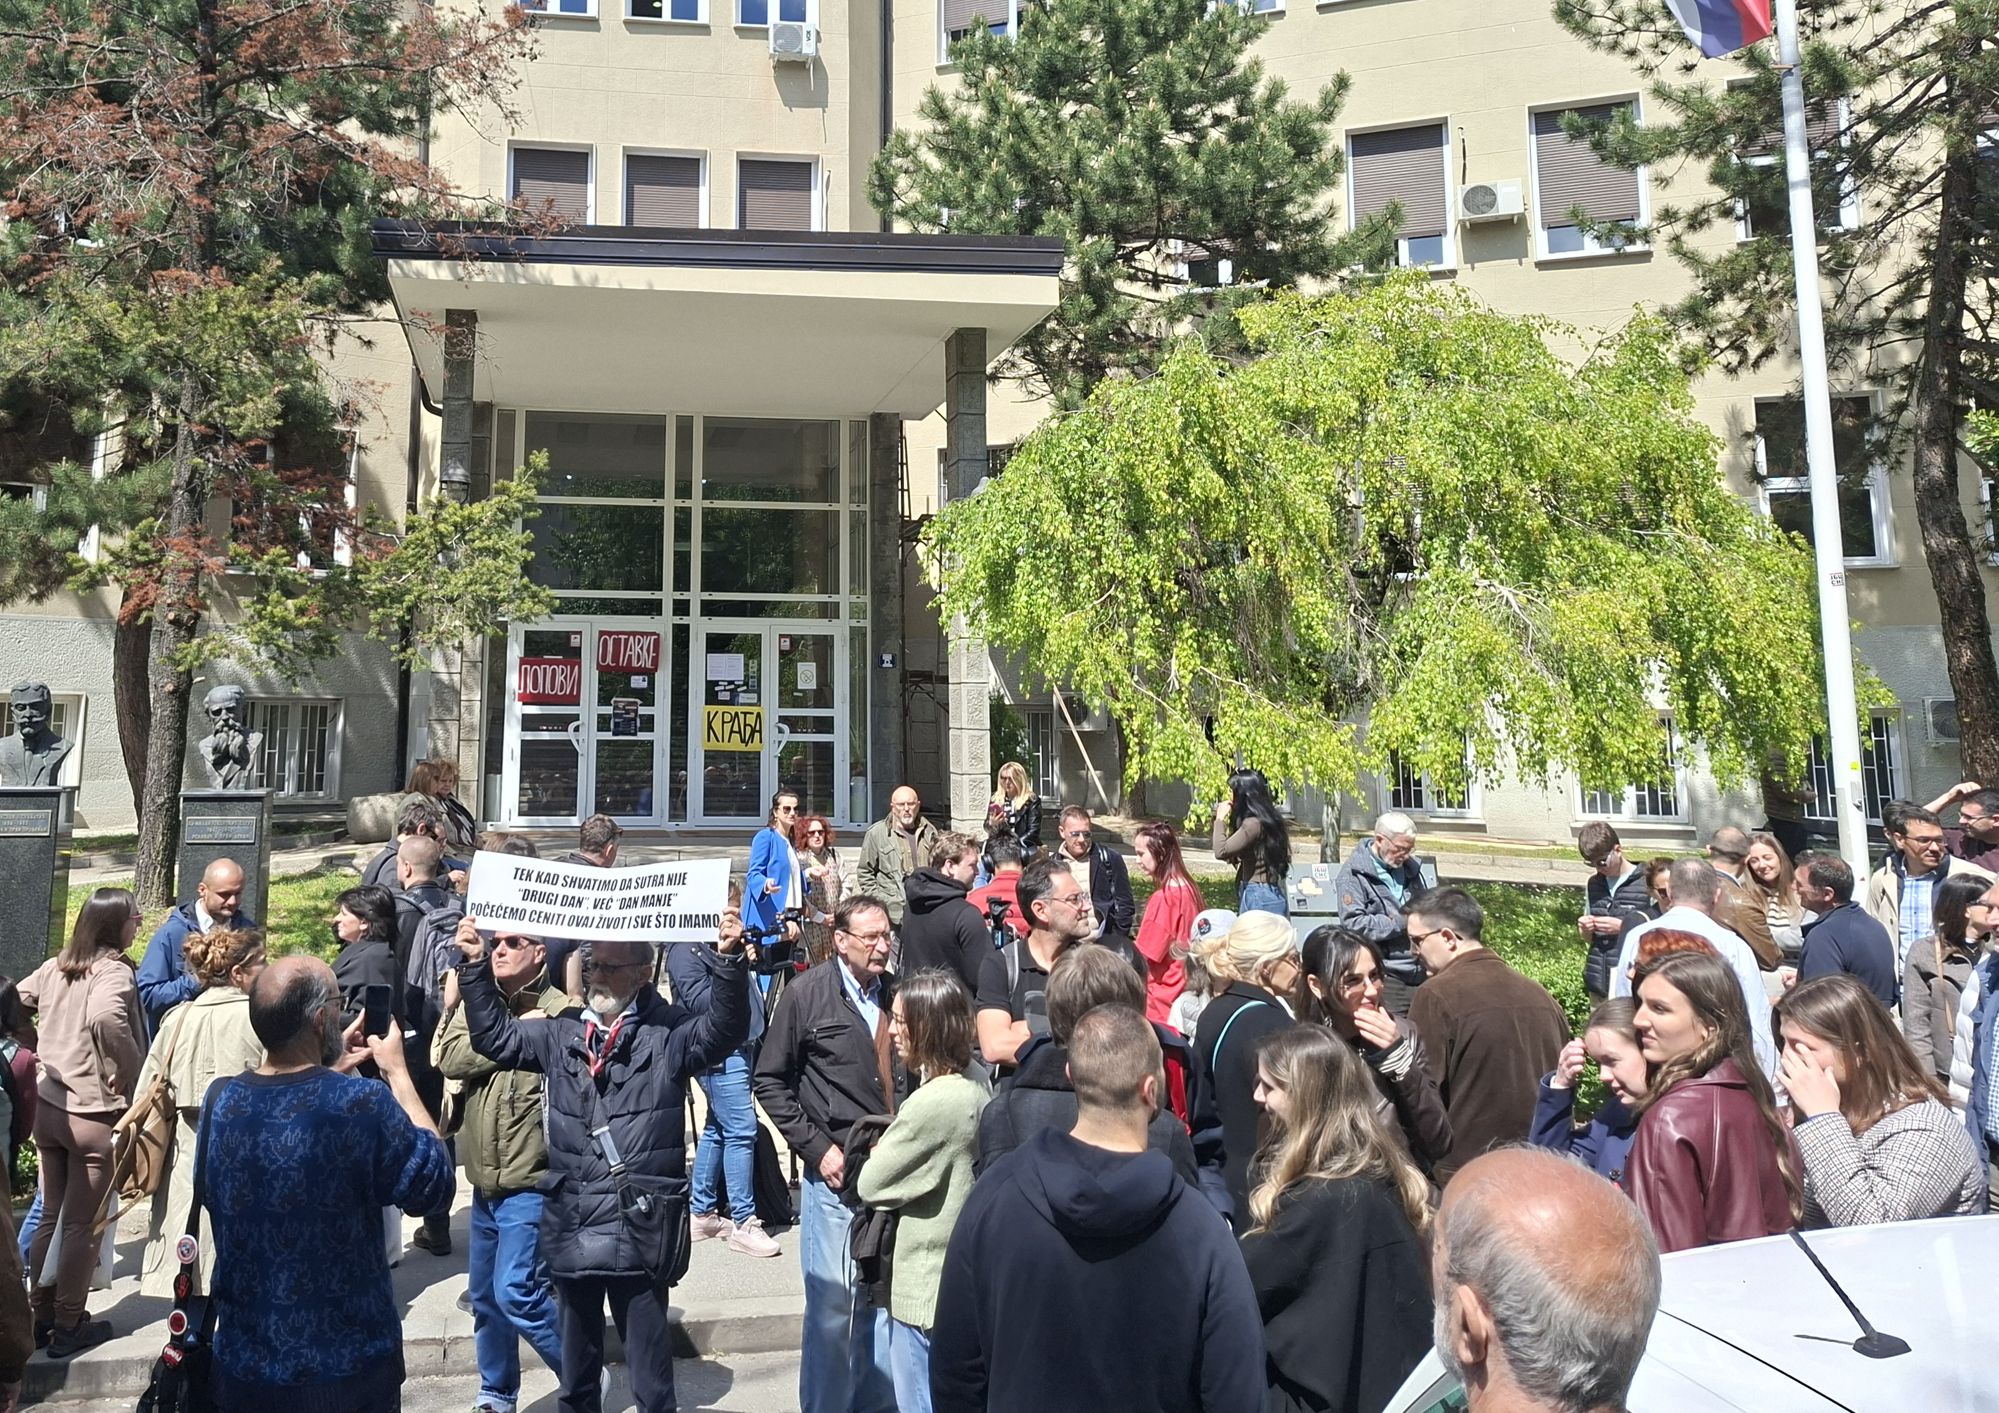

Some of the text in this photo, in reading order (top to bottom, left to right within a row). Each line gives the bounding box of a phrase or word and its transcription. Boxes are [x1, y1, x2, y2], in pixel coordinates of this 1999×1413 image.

[599, 635, 658, 668] ОСТАВКЕ
[518, 664, 579, 695] ЛОПОВИ
[707, 710, 763, 747] КРАЂА
[513, 867, 688, 892] TEK KAD SHVATIMO DA SUTRA NIJE
[470, 901, 527, 921] POČEĆEMO
[528, 909, 566, 926] CENITI
[567, 914, 595, 929] OVAJ
[596, 914, 627, 929] ŽIVOT
[633, 915, 653, 929] SVE
[655, 912, 676, 928] ŠTO
[680, 914, 720, 928] IMAMO
[593, 896, 613, 910] VEĆ
